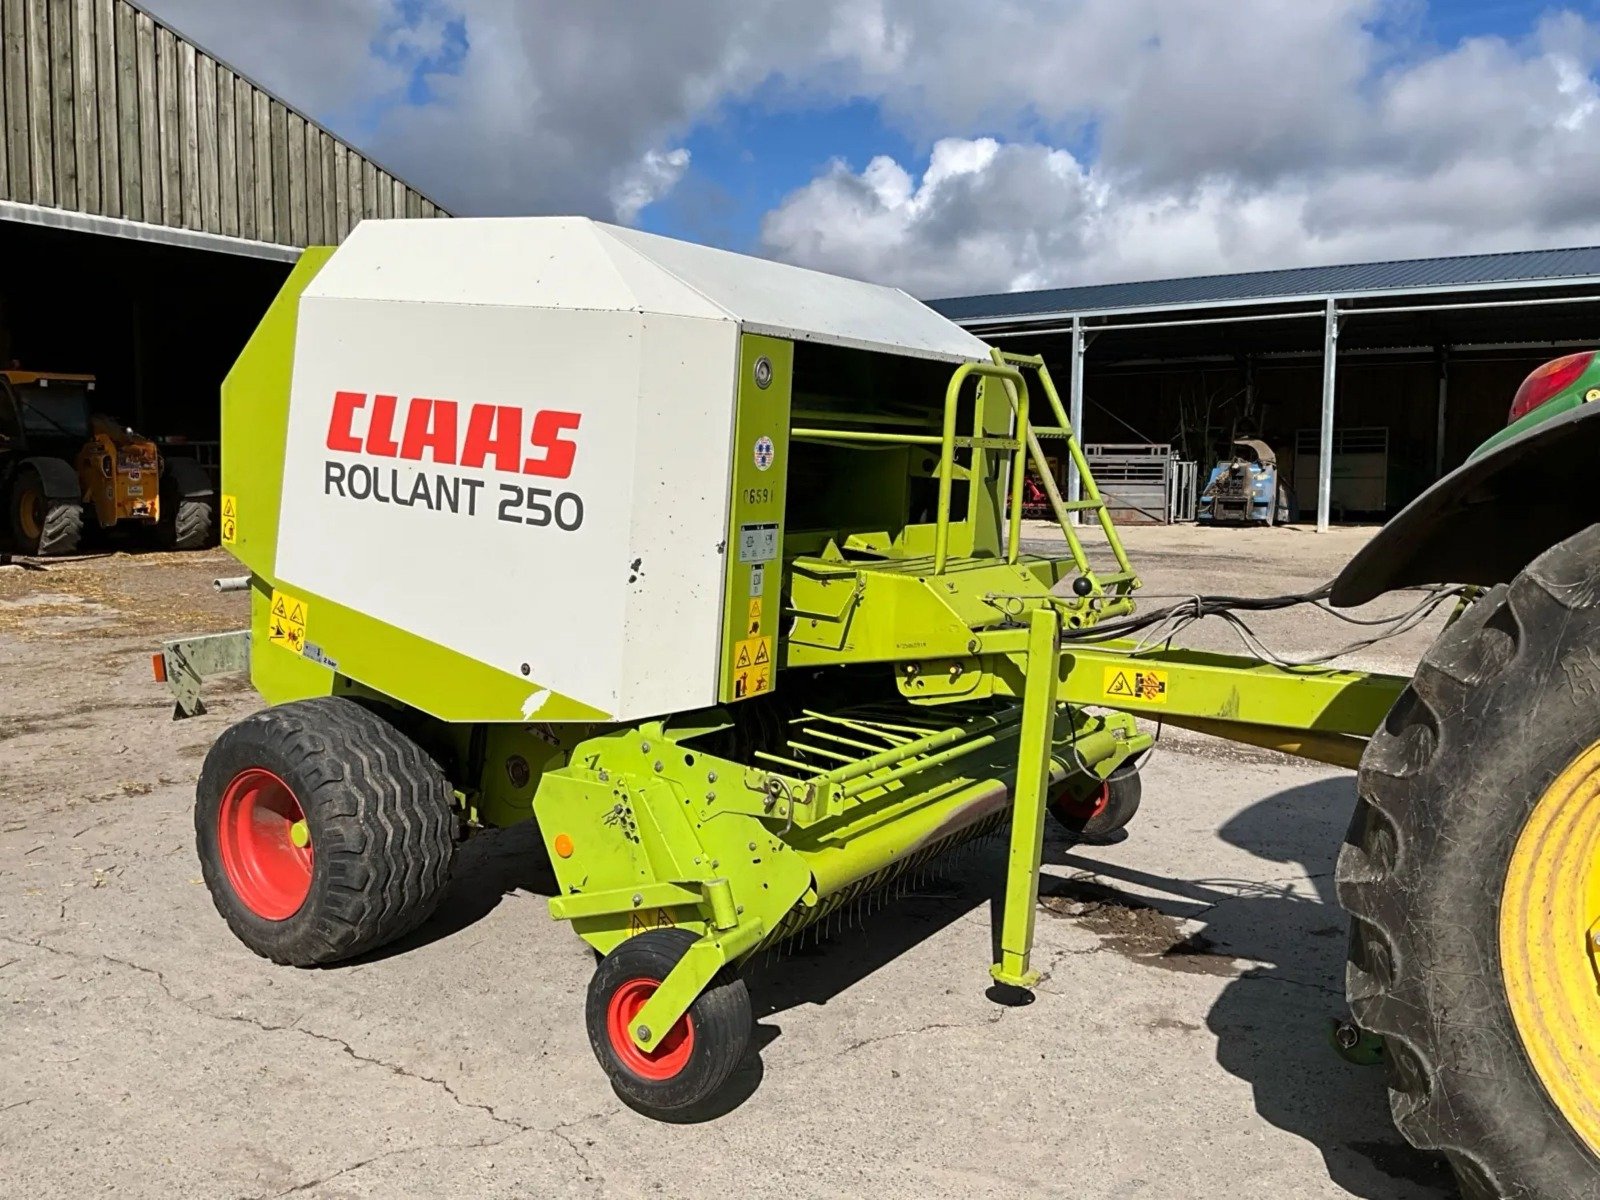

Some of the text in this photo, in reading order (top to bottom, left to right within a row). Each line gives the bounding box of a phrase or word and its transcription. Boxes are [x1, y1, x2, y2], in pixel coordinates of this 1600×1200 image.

[326, 391, 582, 479] CLAAS
[325, 461, 584, 532] ROLLANT 250
